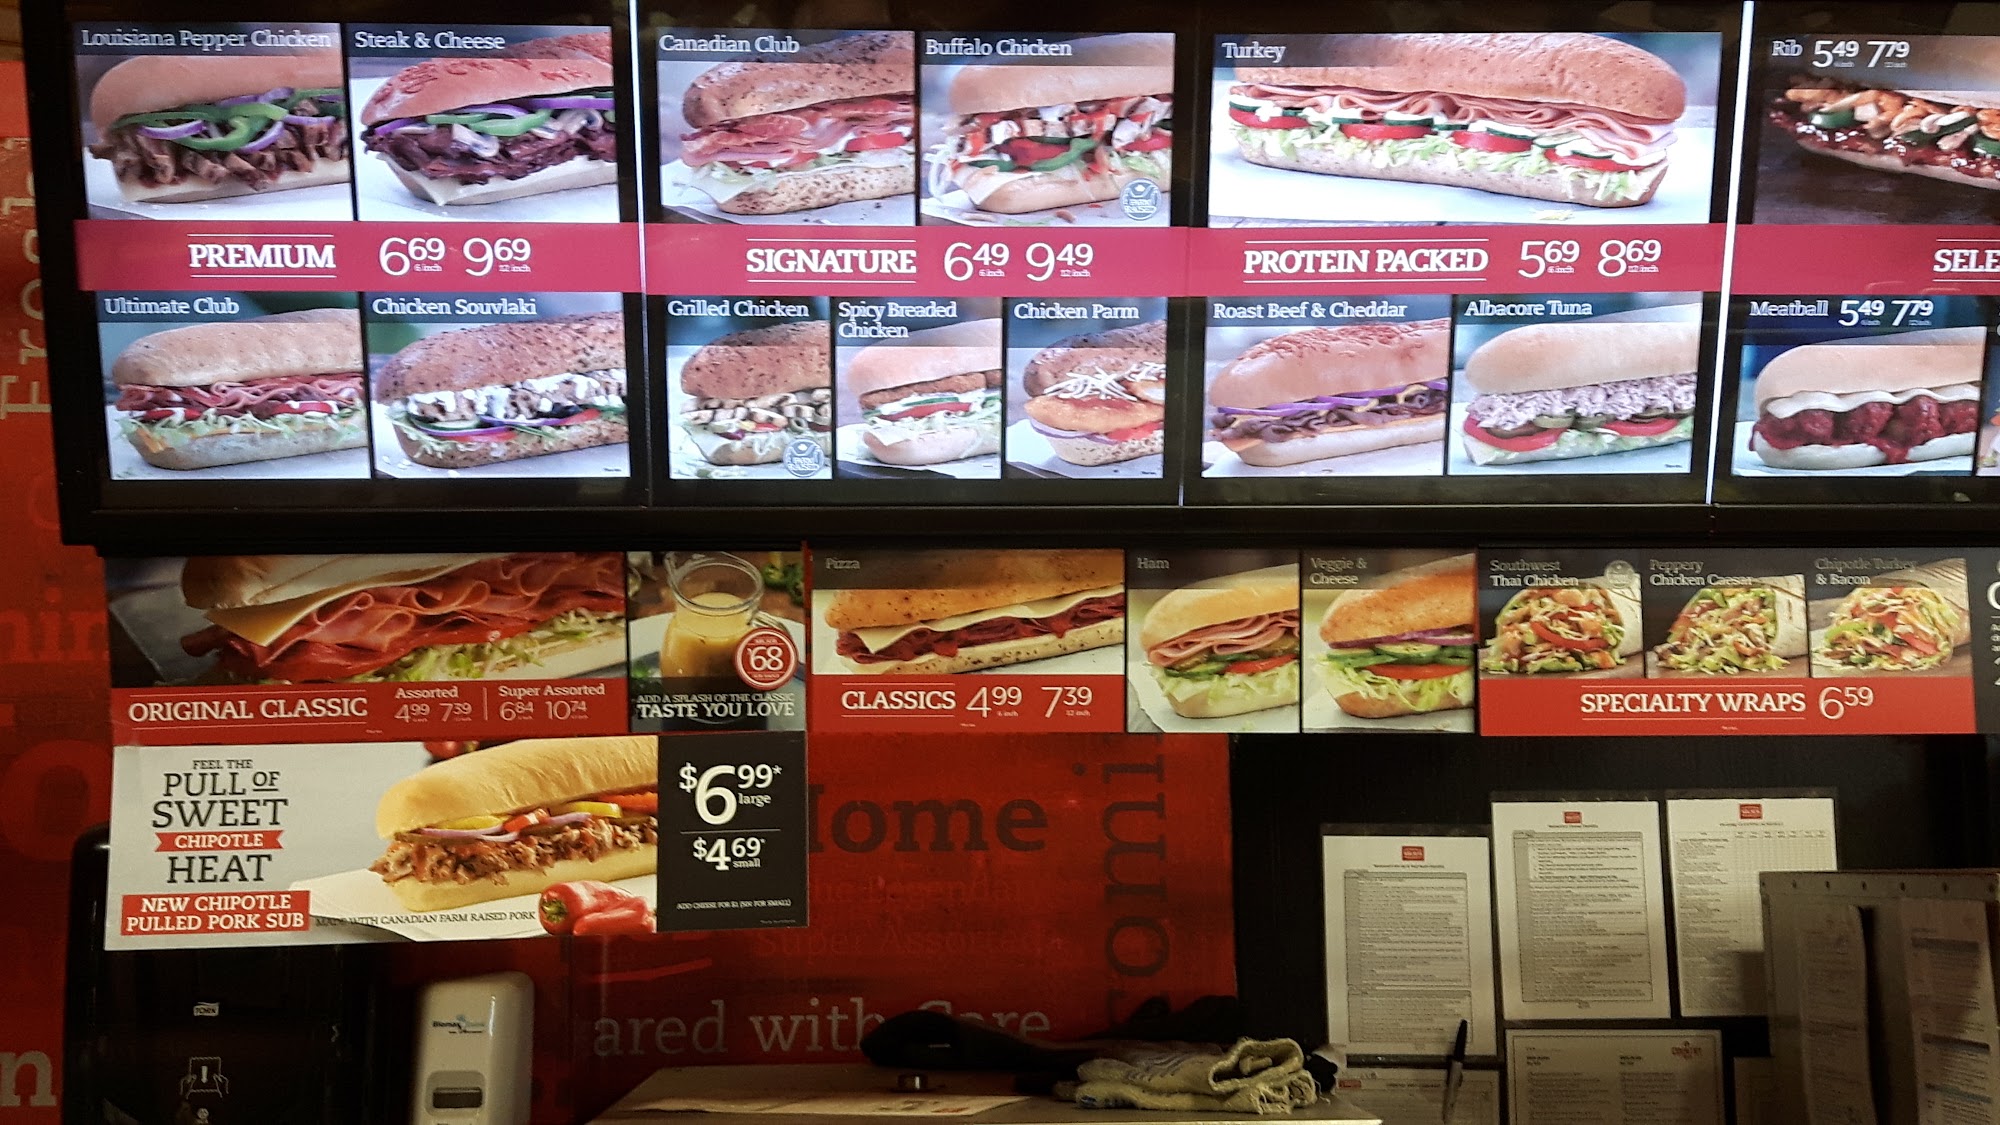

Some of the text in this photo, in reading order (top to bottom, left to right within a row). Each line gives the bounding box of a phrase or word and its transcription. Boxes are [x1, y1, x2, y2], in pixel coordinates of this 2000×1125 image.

[81, 29, 332, 51] Louisiana Pepper Chicken
[354, 31, 506, 50] Steak & Cheese
[658, 34, 800, 53] Canadian Club
[925, 38, 1073, 57] Buffalo Chicken
[1771, 39, 1803, 57] Rib
[1221, 41, 1286, 63] Turkey
[187, 243, 337, 269] PREMIUM
[745, 247, 917, 275] SIGNATURE
[1242, 248, 1490, 274] PROTEIN PACKED
[103, 297, 240, 315] Ultimate Club
[372, 297, 537, 316] Chicken Souvlaki
[667, 300, 809, 318] Grilled Chicken
[838, 301, 958, 322] Spicy Breaded
[1013, 302, 1140, 320] Chicken Parm
[1212, 301, 1408, 320] Roast Beef & Cheddar
[1464, 299, 1594, 317] Albacore Tuna
[1749, 300, 1829, 317] Meatball
[838, 321, 909, 339] Chicken
[825, 555, 861, 571] Pizza
[1136, 557, 1170, 570] Ham
[1310, 557, 1368, 572] Veggie &
[1489, 559, 1562, 572] Southwest
[1650, 559, 1704, 574] Peppery
[1815, 557, 1872, 574] Chipotle
[1310, 573, 1359, 586] Cheese
[1489, 573, 1580, 588] Thai Chicken
[1649, 573, 1705, 587] Chicken
[1706, 573, 1754, 587] Caesar
[1814, 573, 1872, 586] & Bacon
[394, 685, 459, 699] Assorted
[498, 683, 606, 700] Super Assorted
[841, 690, 957, 711] CLASSICS
[128, 697, 368, 723] ORIGINAL CLASSIC
[637, 701, 795, 718] TASTE YOU LOVE
[1580, 692, 1713, 714] SPECIALTY
[1717, 692, 1807, 713] WRAPS
[192, 758, 253, 770] FEEL THE
[163, 771, 281, 797] PULL OF
[738, 792, 772, 807] large
[152, 798, 289, 829] SWEET
[174, 833, 264, 849] CHIPOTLE
[166, 853, 273, 884] HEAT
[732, 857, 761, 869] small
[141, 894, 292, 913] NEW CHIPOTLE
[126, 912, 305, 932] PULLED PORK SUB
[350, 916, 379, 926] WITH
[381, 914, 439, 925] CANADIAN
[439, 913, 469, 923] FARM
[470, 911, 507, 922] RAISED
[509, 910, 537, 921] PORK
